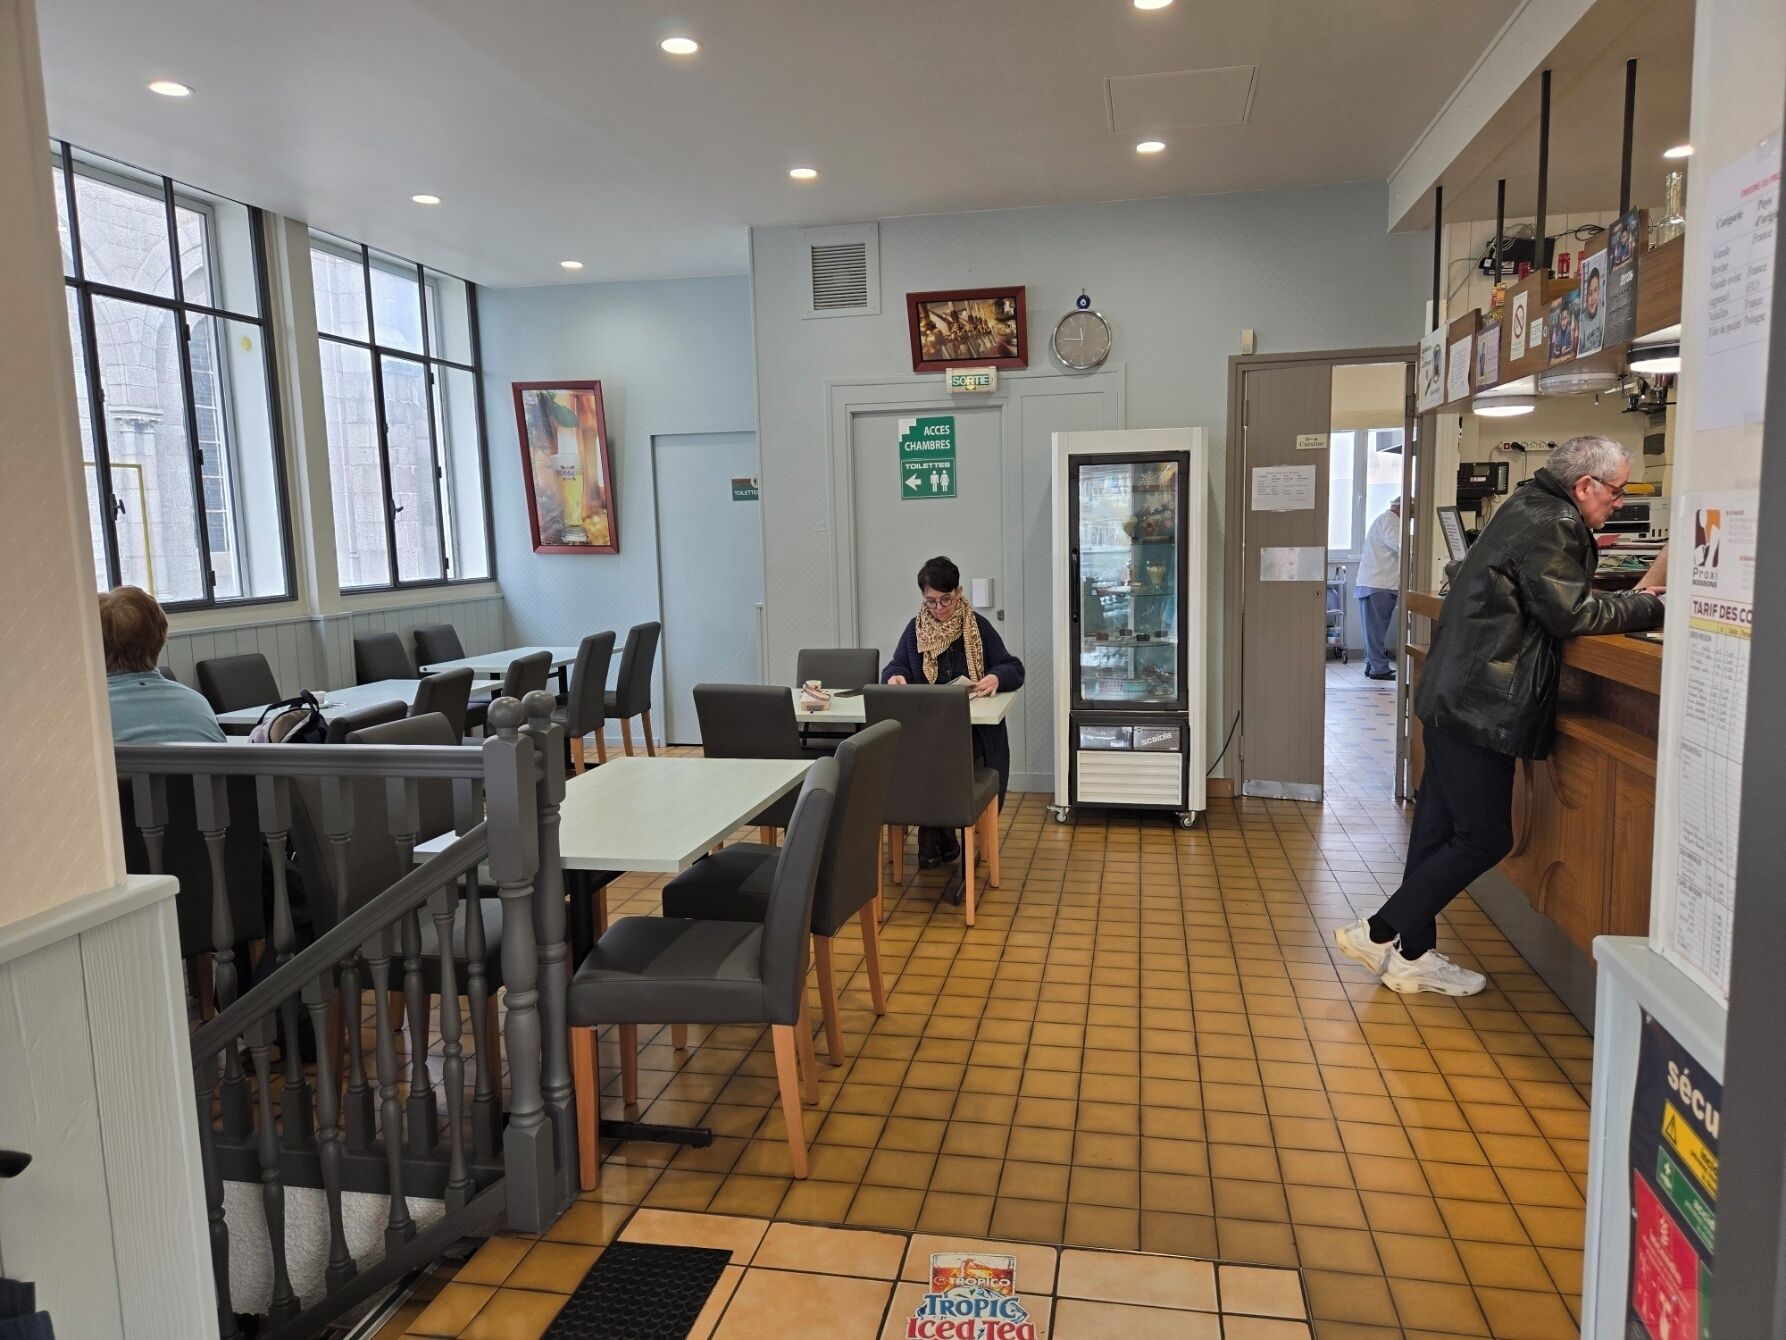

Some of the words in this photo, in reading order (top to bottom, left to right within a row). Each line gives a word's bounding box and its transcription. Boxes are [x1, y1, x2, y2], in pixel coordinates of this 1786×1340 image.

[952, 375, 989, 386] SORTIE
[924, 425, 950, 436] ACCES
[904, 440, 951, 451] CHAMBRES
[905, 462, 951, 470] TOILETTES
[1692, 567, 1718, 580] Proxi
[1693, 600, 1718, 617] TARIF
[1719, 605, 1738, 621] DES
[950, 1276, 1012, 1287] TROPICO
[923, 1294, 1020, 1319] TROPIC
